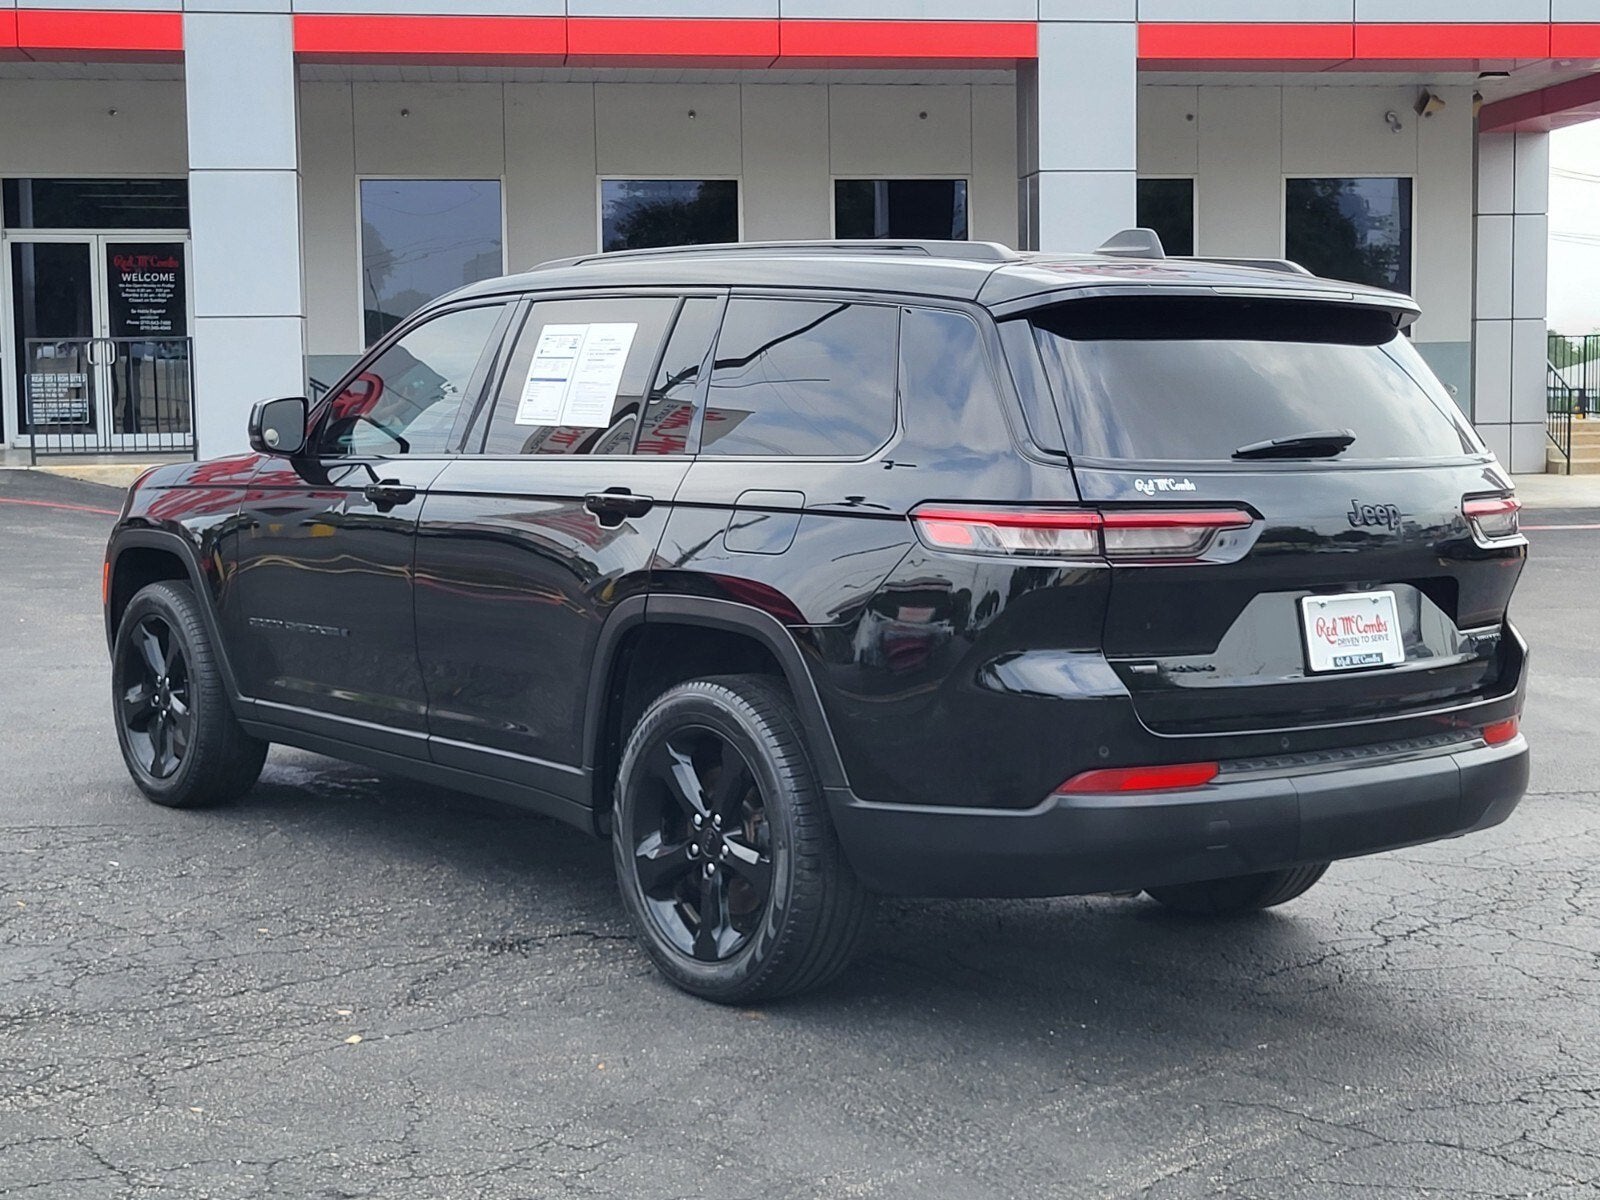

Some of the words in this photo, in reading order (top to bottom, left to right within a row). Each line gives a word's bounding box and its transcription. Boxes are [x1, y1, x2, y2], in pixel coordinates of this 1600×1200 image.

[121, 272, 175, 282] WELCOME
[1134, 478, 1156, 496] Red
[1346, 498, 1402, 531] Jeep
[1315, 616, 1339, 645] Red
[1338, 613, 1388, 636] McCombs
[1337, 636, 1361, 646] DRIVEN
[1360, 635, 1370, 644] TO
[1370, 633, 1389, 643] SERVE
